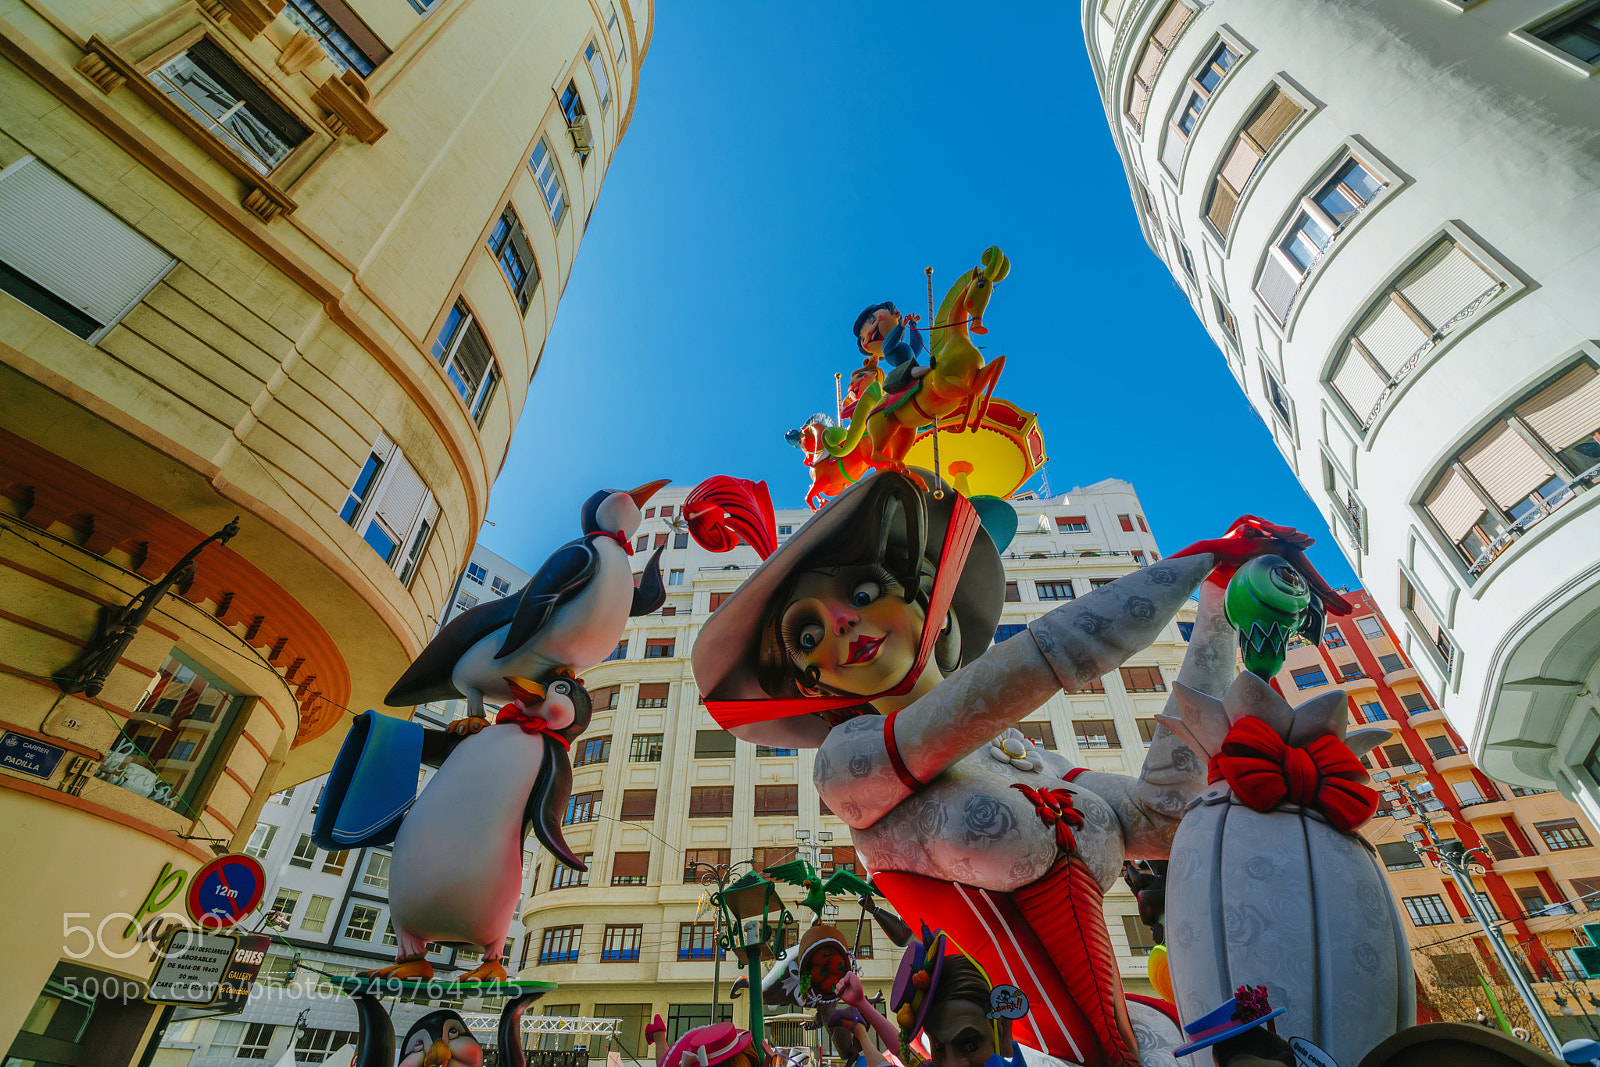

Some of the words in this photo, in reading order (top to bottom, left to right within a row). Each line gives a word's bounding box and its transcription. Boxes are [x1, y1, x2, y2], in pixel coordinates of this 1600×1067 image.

[67, 719, 77, 728] 9
[22, 742, 50, 755] CARRER
[24, 752, 36, 760] DE
[4, 755, 40, 771] PADILLA
[215, 884, 239, 899] 12m
[177, 953, 217, 964] LABORABLES
[235, 948, 265, 966] CHES
[228, 970, 254, 981] GALLERY
